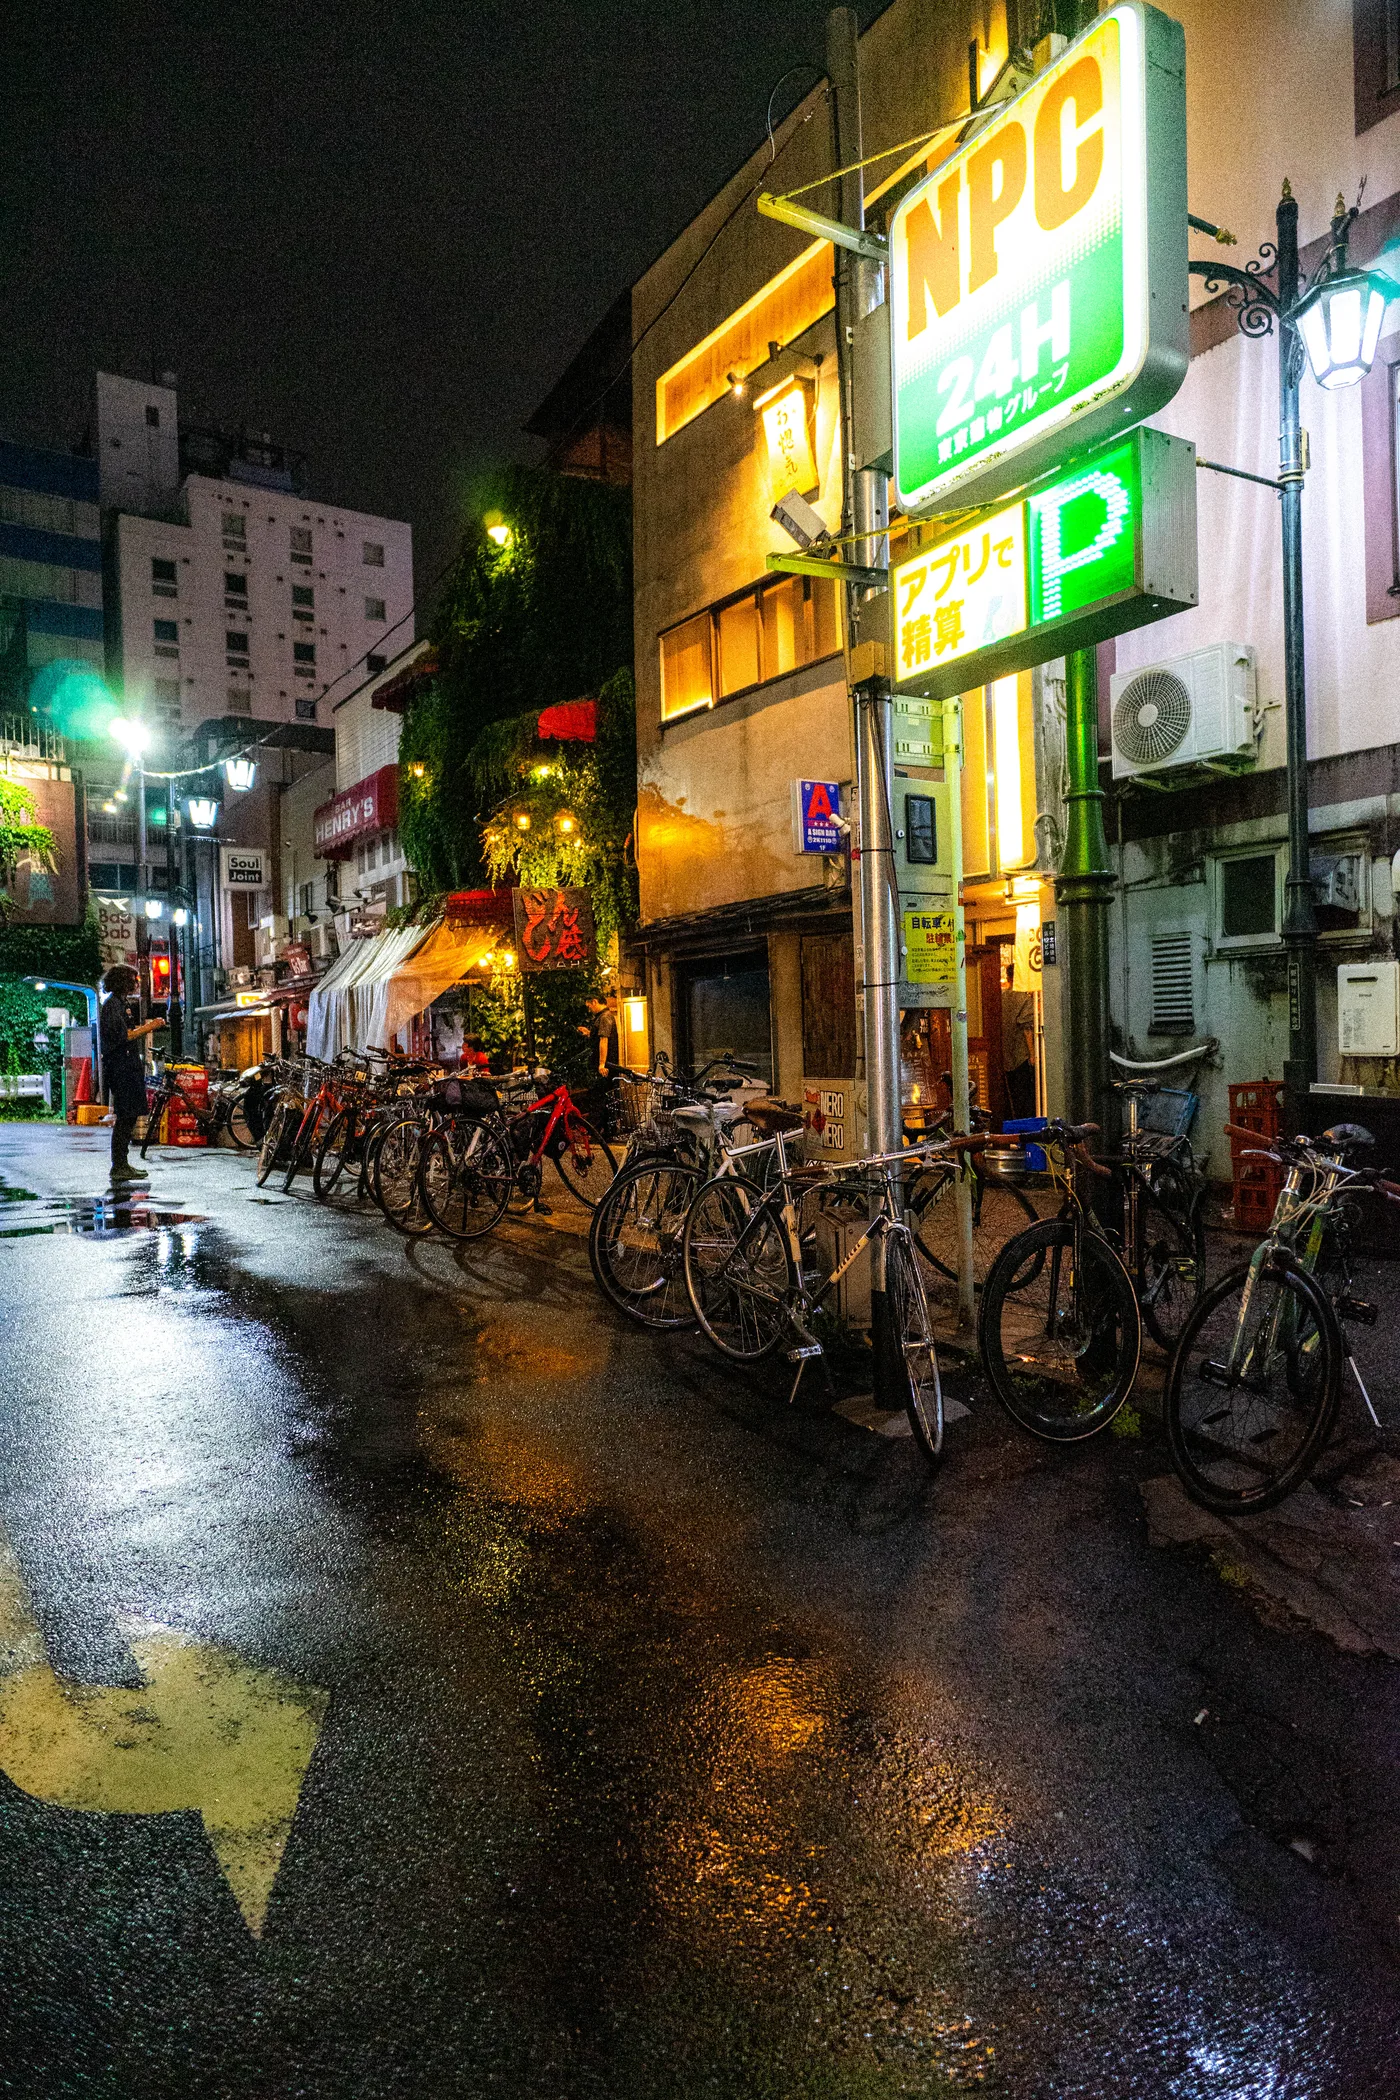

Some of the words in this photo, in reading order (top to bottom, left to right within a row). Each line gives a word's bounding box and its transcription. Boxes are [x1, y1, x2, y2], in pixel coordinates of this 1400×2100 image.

[907, 56, 1104, 341] NPC
[936, 280, 1070, 437] 24H
[1040, 469, 1129, 620] P
[900, 533, 1014, 617] アプリで
[901, 599, 965, 669] 精算
[316, 796, 374, 844] HENRY'S
[336, 798, 352, 813] BAR
[807, 783, 832, 819] A
[230, 857, 260, 869] Soul
[231, 871, 260, 882] Joint
[522, 889, 587, 961] どん底
[820, 1091, 844, 1118] NERO
